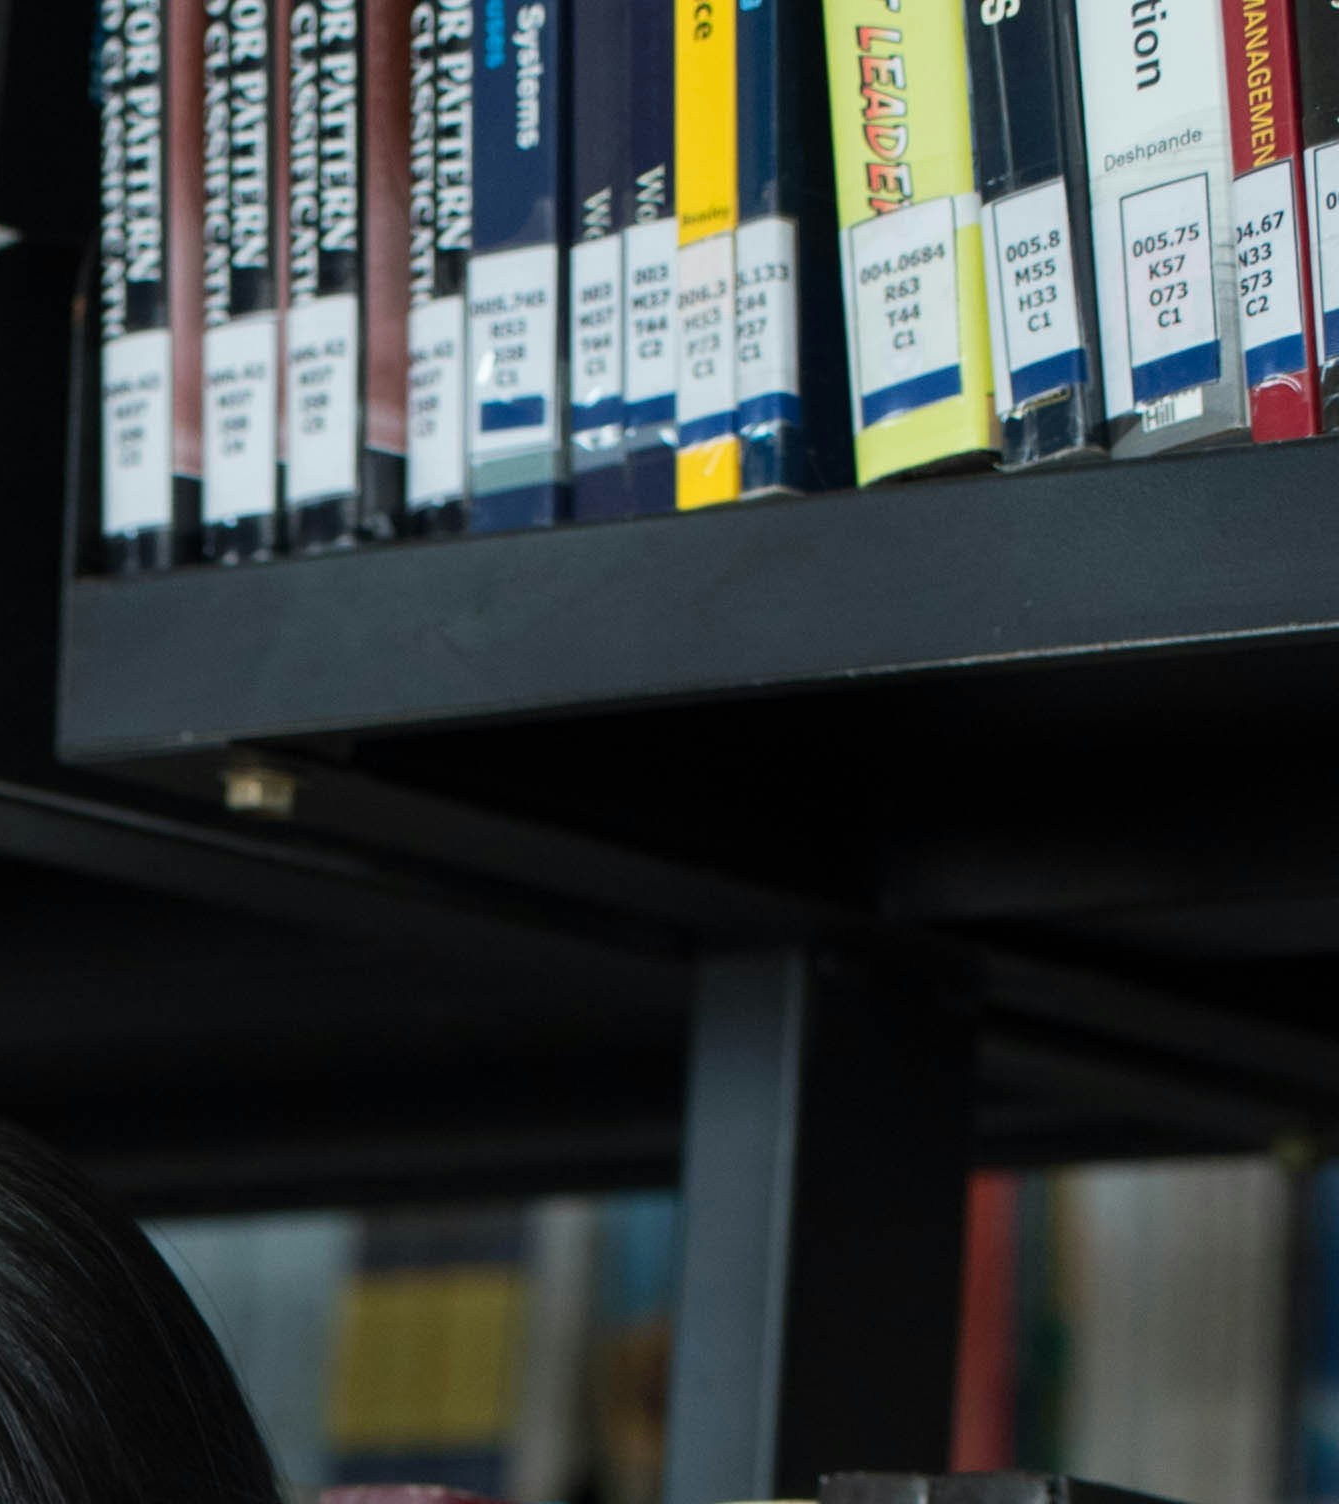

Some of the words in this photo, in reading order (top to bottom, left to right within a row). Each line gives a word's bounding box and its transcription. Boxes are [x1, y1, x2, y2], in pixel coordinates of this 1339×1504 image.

[511, 3, 547, 151] Systems
[1242, 0, 1278, 168] MANAGEMEN
[320, 52, 357, 251] PATTERN
[437, 51, 473, 250] PATTERN
[1103, 127, 1204, 174] Deshpande
[124, 83, 161, 282] PATTERN
[229, 67, 268, 268] PATTERN
[1005, 229, 1062, 263] 005.8
[1132, 222, 1201, 258] 005.75
[1013, 257, 1056, 287] M55
[1148, 254, 1186, 281] K57
[884, 276, 921, 303] R63
[1018, 284, 1058, 313] H33
[885, 302, 923, 329] T44
[1027, 311, 1052, 332] C1
[1157, 307, 1182, 329] C1
[1245, 296, 1270, 318] C2
[893, 329, 917, 350] C1
